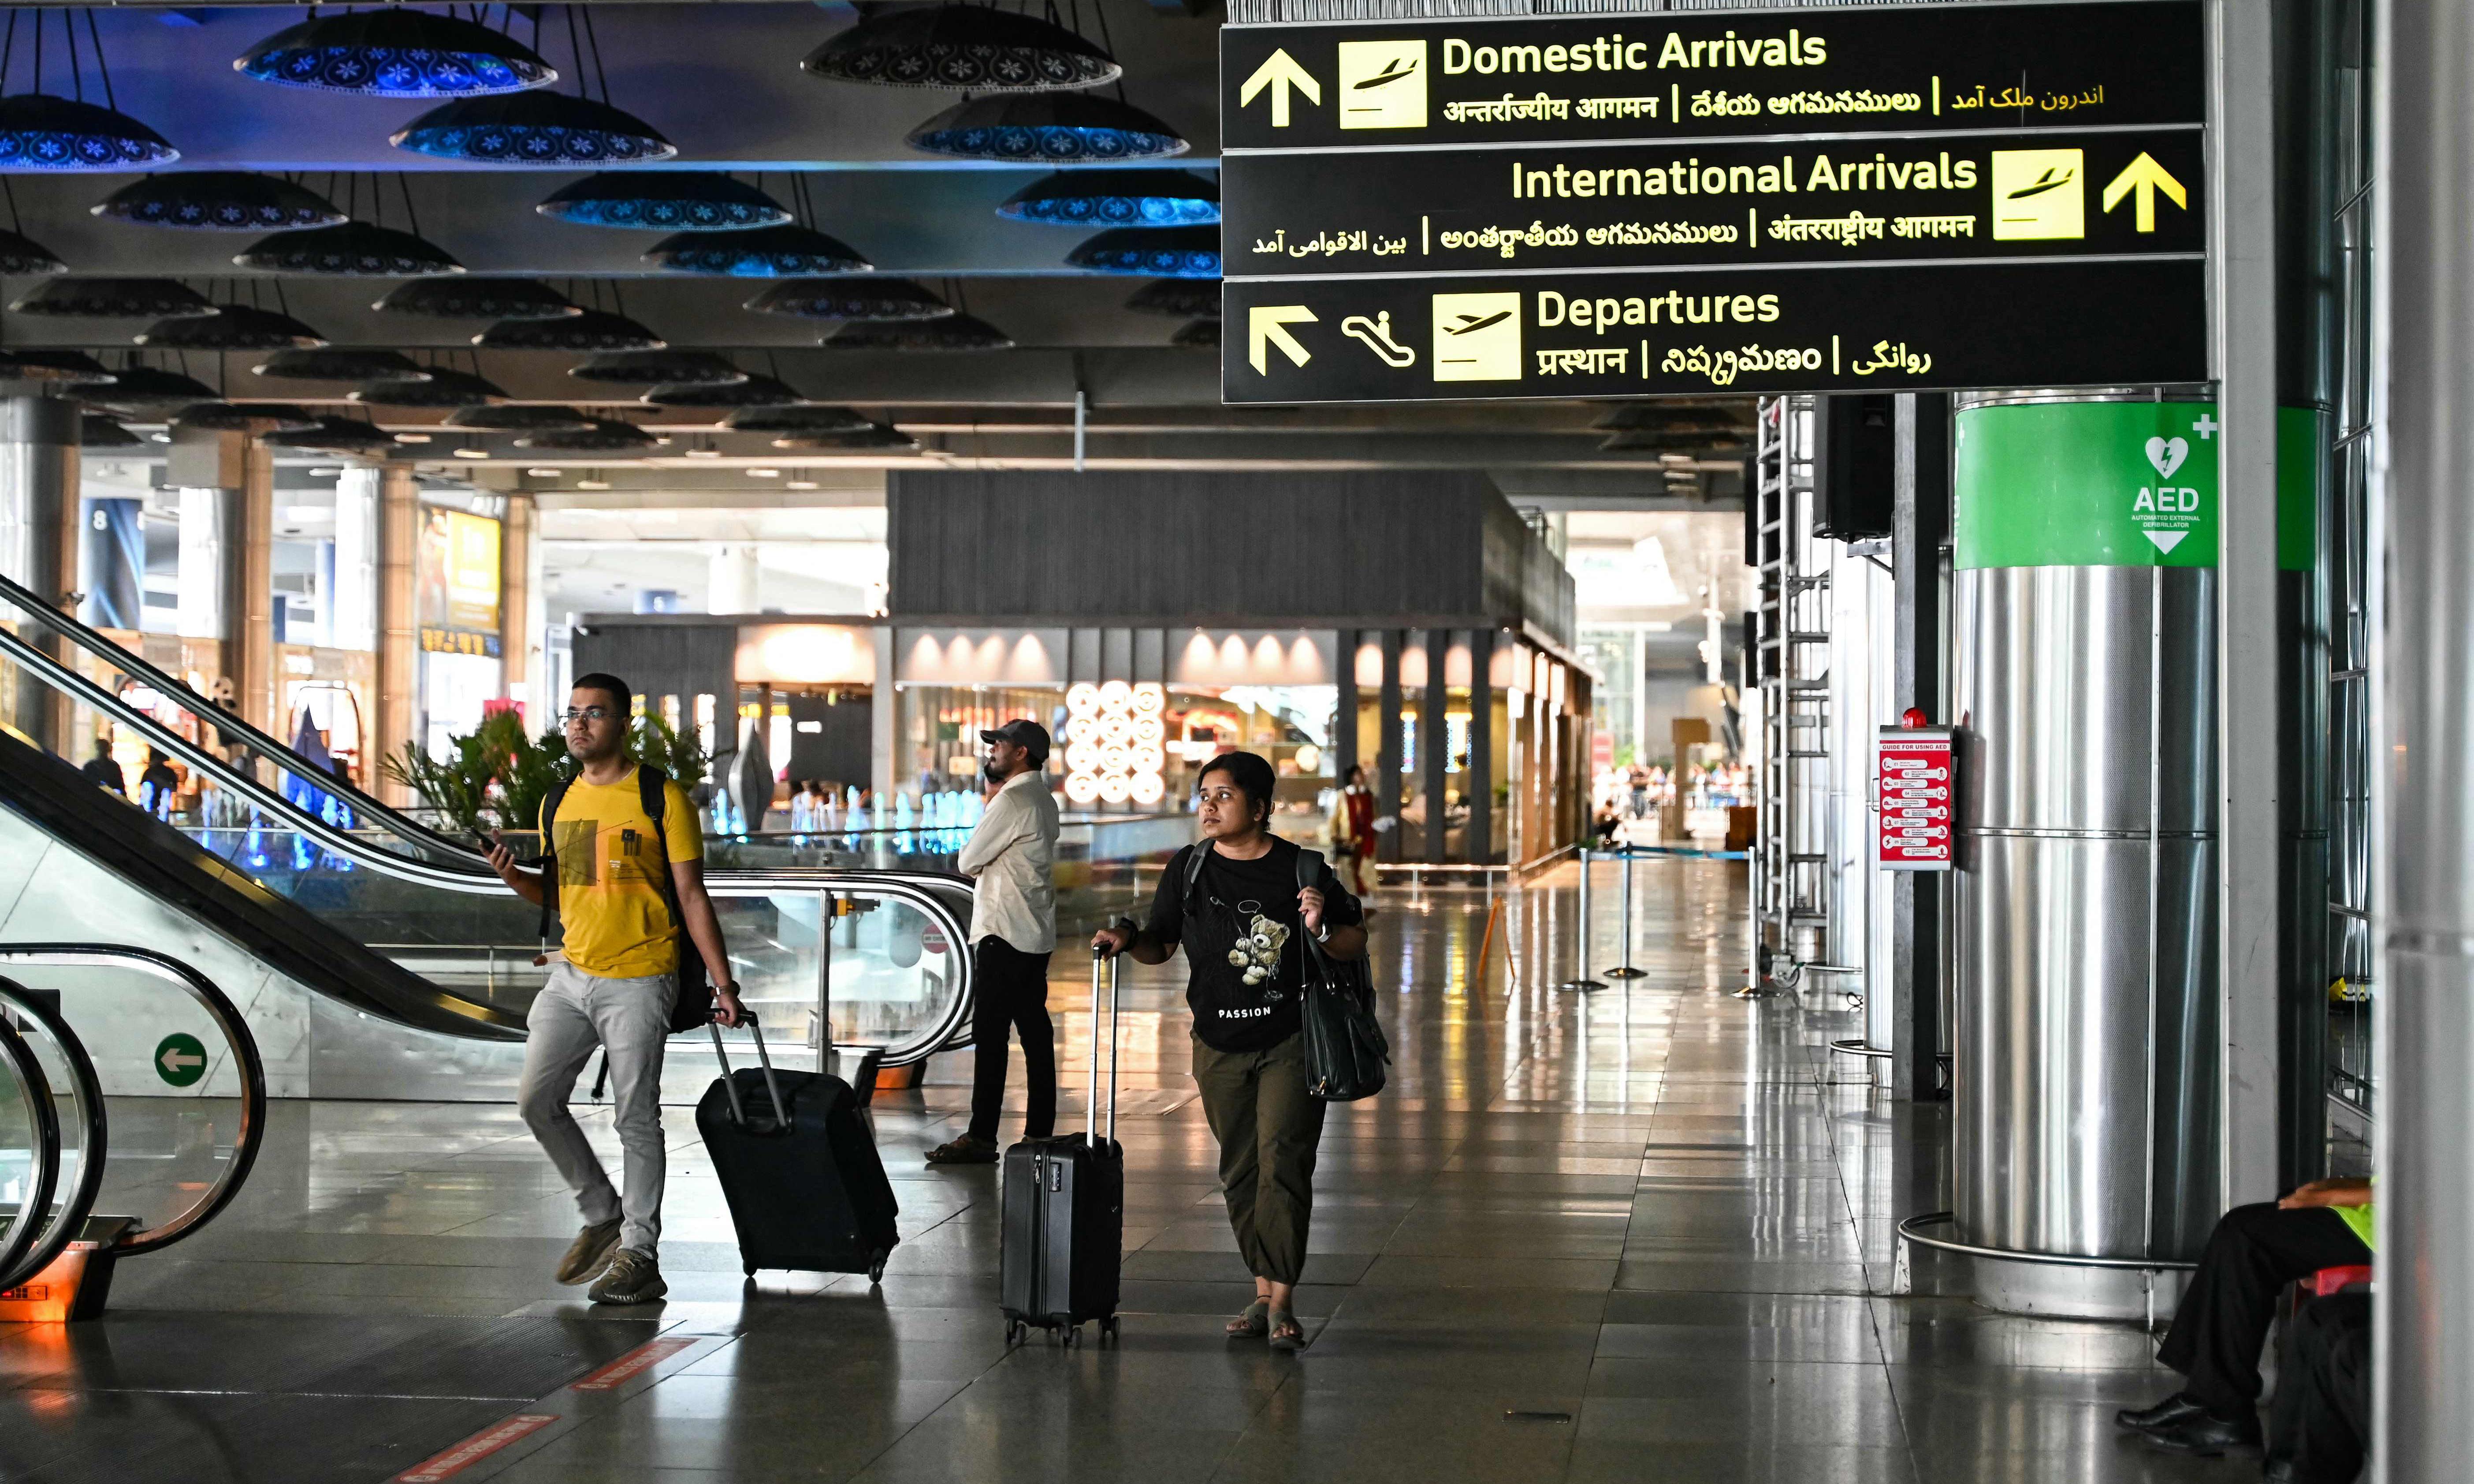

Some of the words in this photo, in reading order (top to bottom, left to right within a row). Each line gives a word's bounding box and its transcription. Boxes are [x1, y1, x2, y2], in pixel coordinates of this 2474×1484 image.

[1443, 33, 1647, 74] Domestic
[1657, 29, 1827, 69] Arrivals
[1443, 92, 1571, 122] अन्तर्राज्यीय
[1575, 96, 1659, 119] आगमन
[1690, 89, 1760, 117] దేశీయ
[1767, 89, 1921, 115] ఆగమనములు
[1951, 85, 1985, 109] آمد
[1990, 87, 2035, 108] ملک
[2040, 85, 2104, 111] اندرون
[1513, 156, 1797, 198] International
[1806, 152, 1977, 192] Arrivals
[1252, 229, 1285, 253] آمد
[1440, 220, 1579, 258] అంతర్జాతీయ
[1585, 221, 1738, 245] ఆగమనములు
[1767, 210, 1886, 246] अंतरराष्ट्रीय
[1890, 215, 1976, 238] आगमन
[1288, 230, 1367, 258] الاقوامی
[1373, 235, 1406, 256] بین
[1538, 290, 1780, 335] Departures
[1536, 348, 1629, 375] प्रस्थान
[1661, 343, 1822, 385] నిష్క్రమణం
[1852, 340, 1931, 375] روانگی
[2133, 487, 2199, 512] AED
[93, 509, 108, 531] 8
[1218, 1006, 1271, 1019] PASSION
